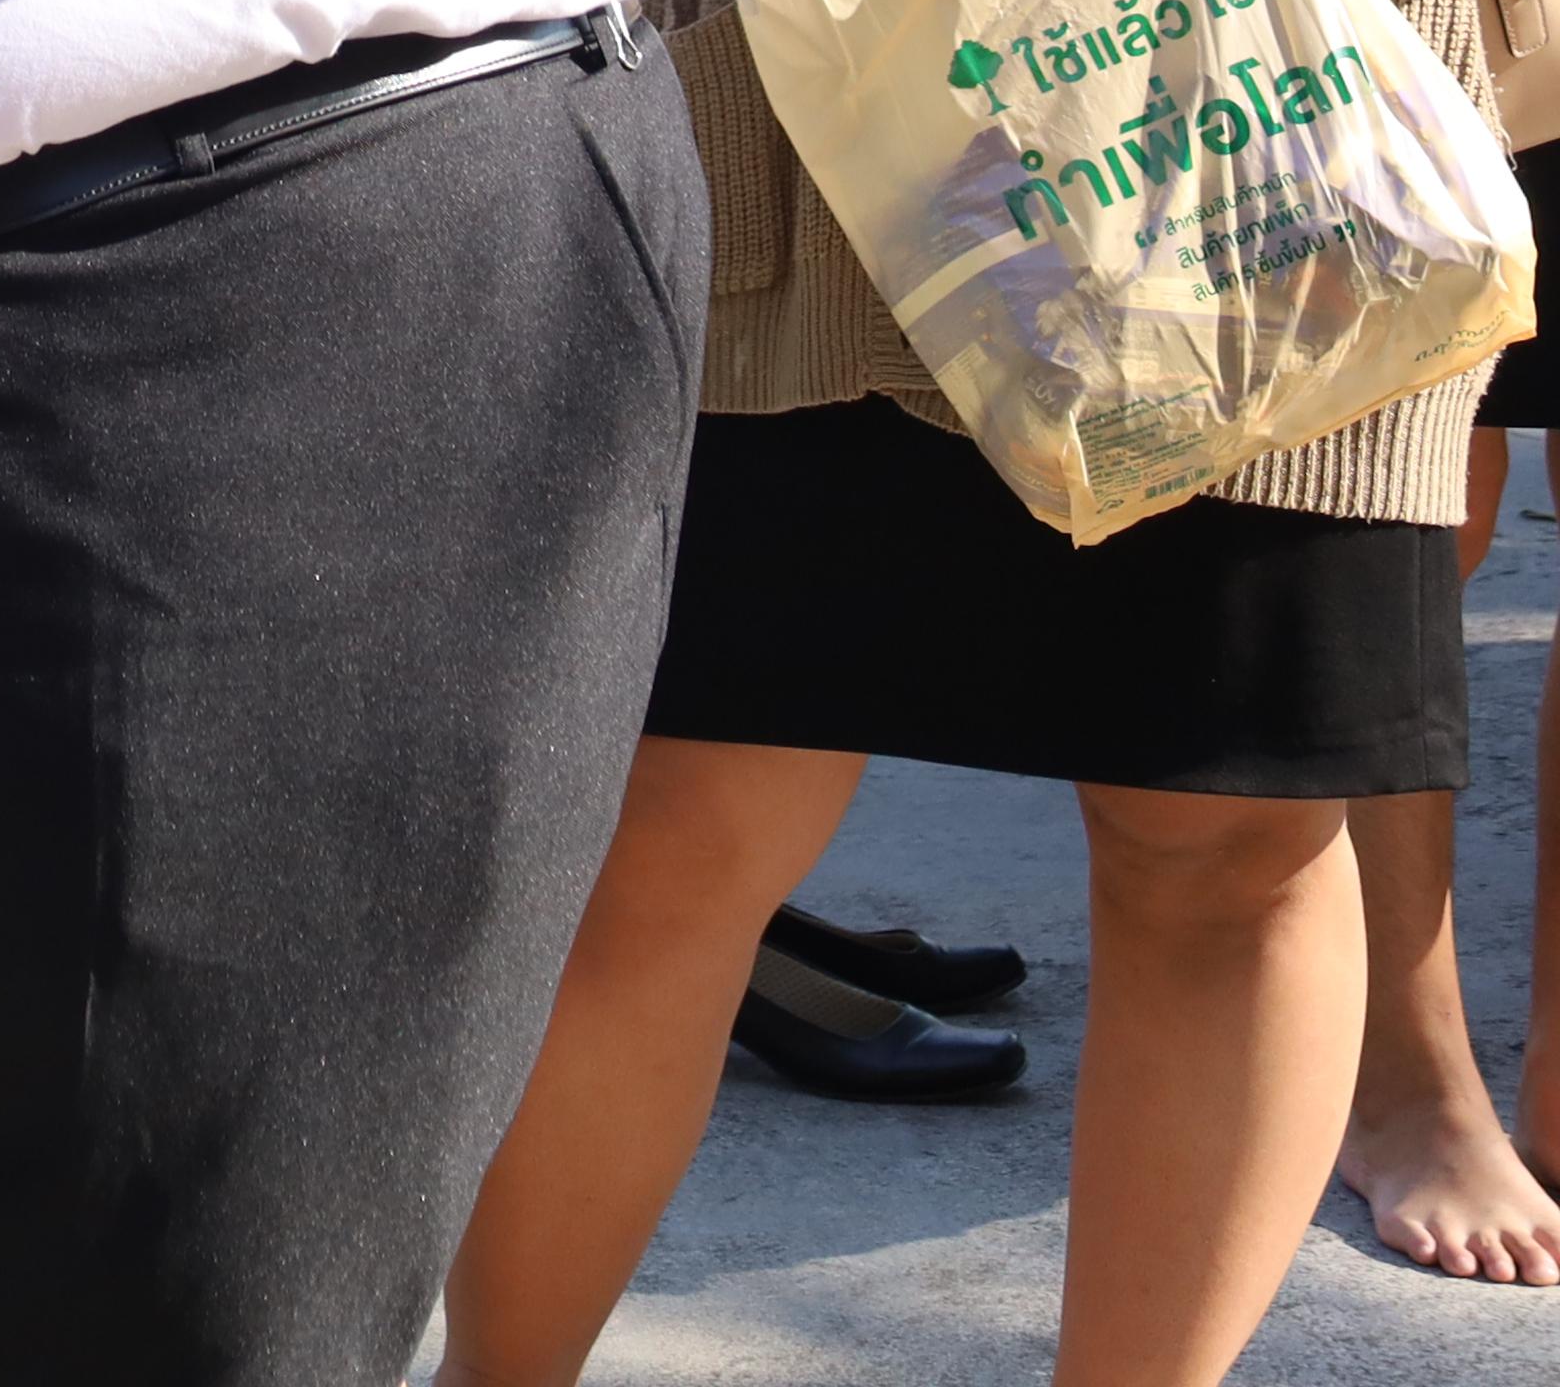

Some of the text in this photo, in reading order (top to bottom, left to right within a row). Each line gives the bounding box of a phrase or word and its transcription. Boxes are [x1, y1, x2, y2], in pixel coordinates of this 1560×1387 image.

[1003, 45, 1373, 242] ทำเพื่อโลก
[1164, 171, 1297, 236] สำหรับสินค้าหนัก
[1176, 199, 1312, 269] สินค้ายกแพ็ก
[1191, 273, 1240, 302] สินค้า
[1258, 231, 1326, 274] ชิ้นขึ้นไป
